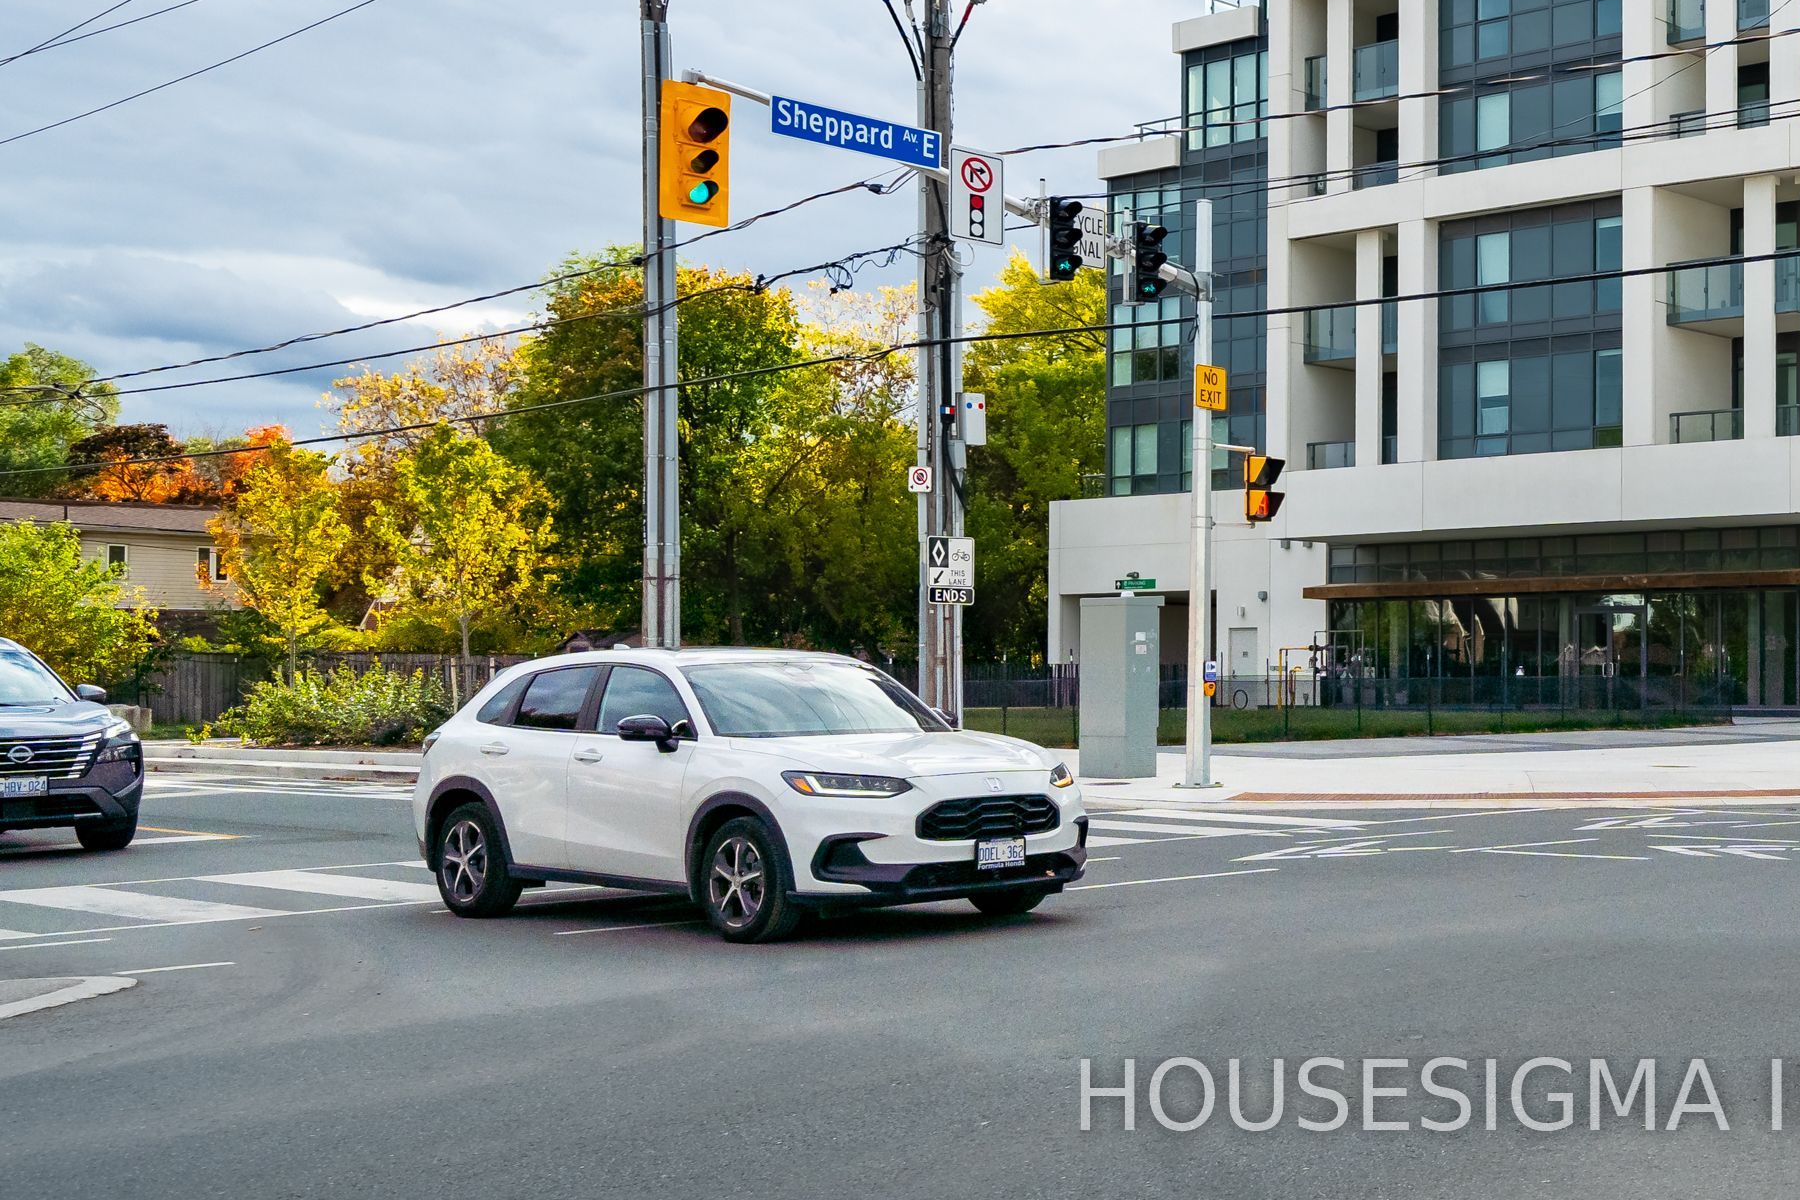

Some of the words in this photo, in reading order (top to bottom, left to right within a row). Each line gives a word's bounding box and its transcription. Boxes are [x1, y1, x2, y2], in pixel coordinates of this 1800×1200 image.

[777, 99, 893, 149] Sheppard
[923, 133, 935, 159] E
[1076, 214, 1103, 236] YCLE
[1203, 371, 1218, 386] NO
[1200, 388, 1222, 405] EXIT
[950, 569, 966, 577] THIS
[948, 578, 967, 586] LANE
[935, 589, 967, 602] ENDS
[977, 862, 1004, 870] Formula
[1005, 860, 1026, 868] Honda
